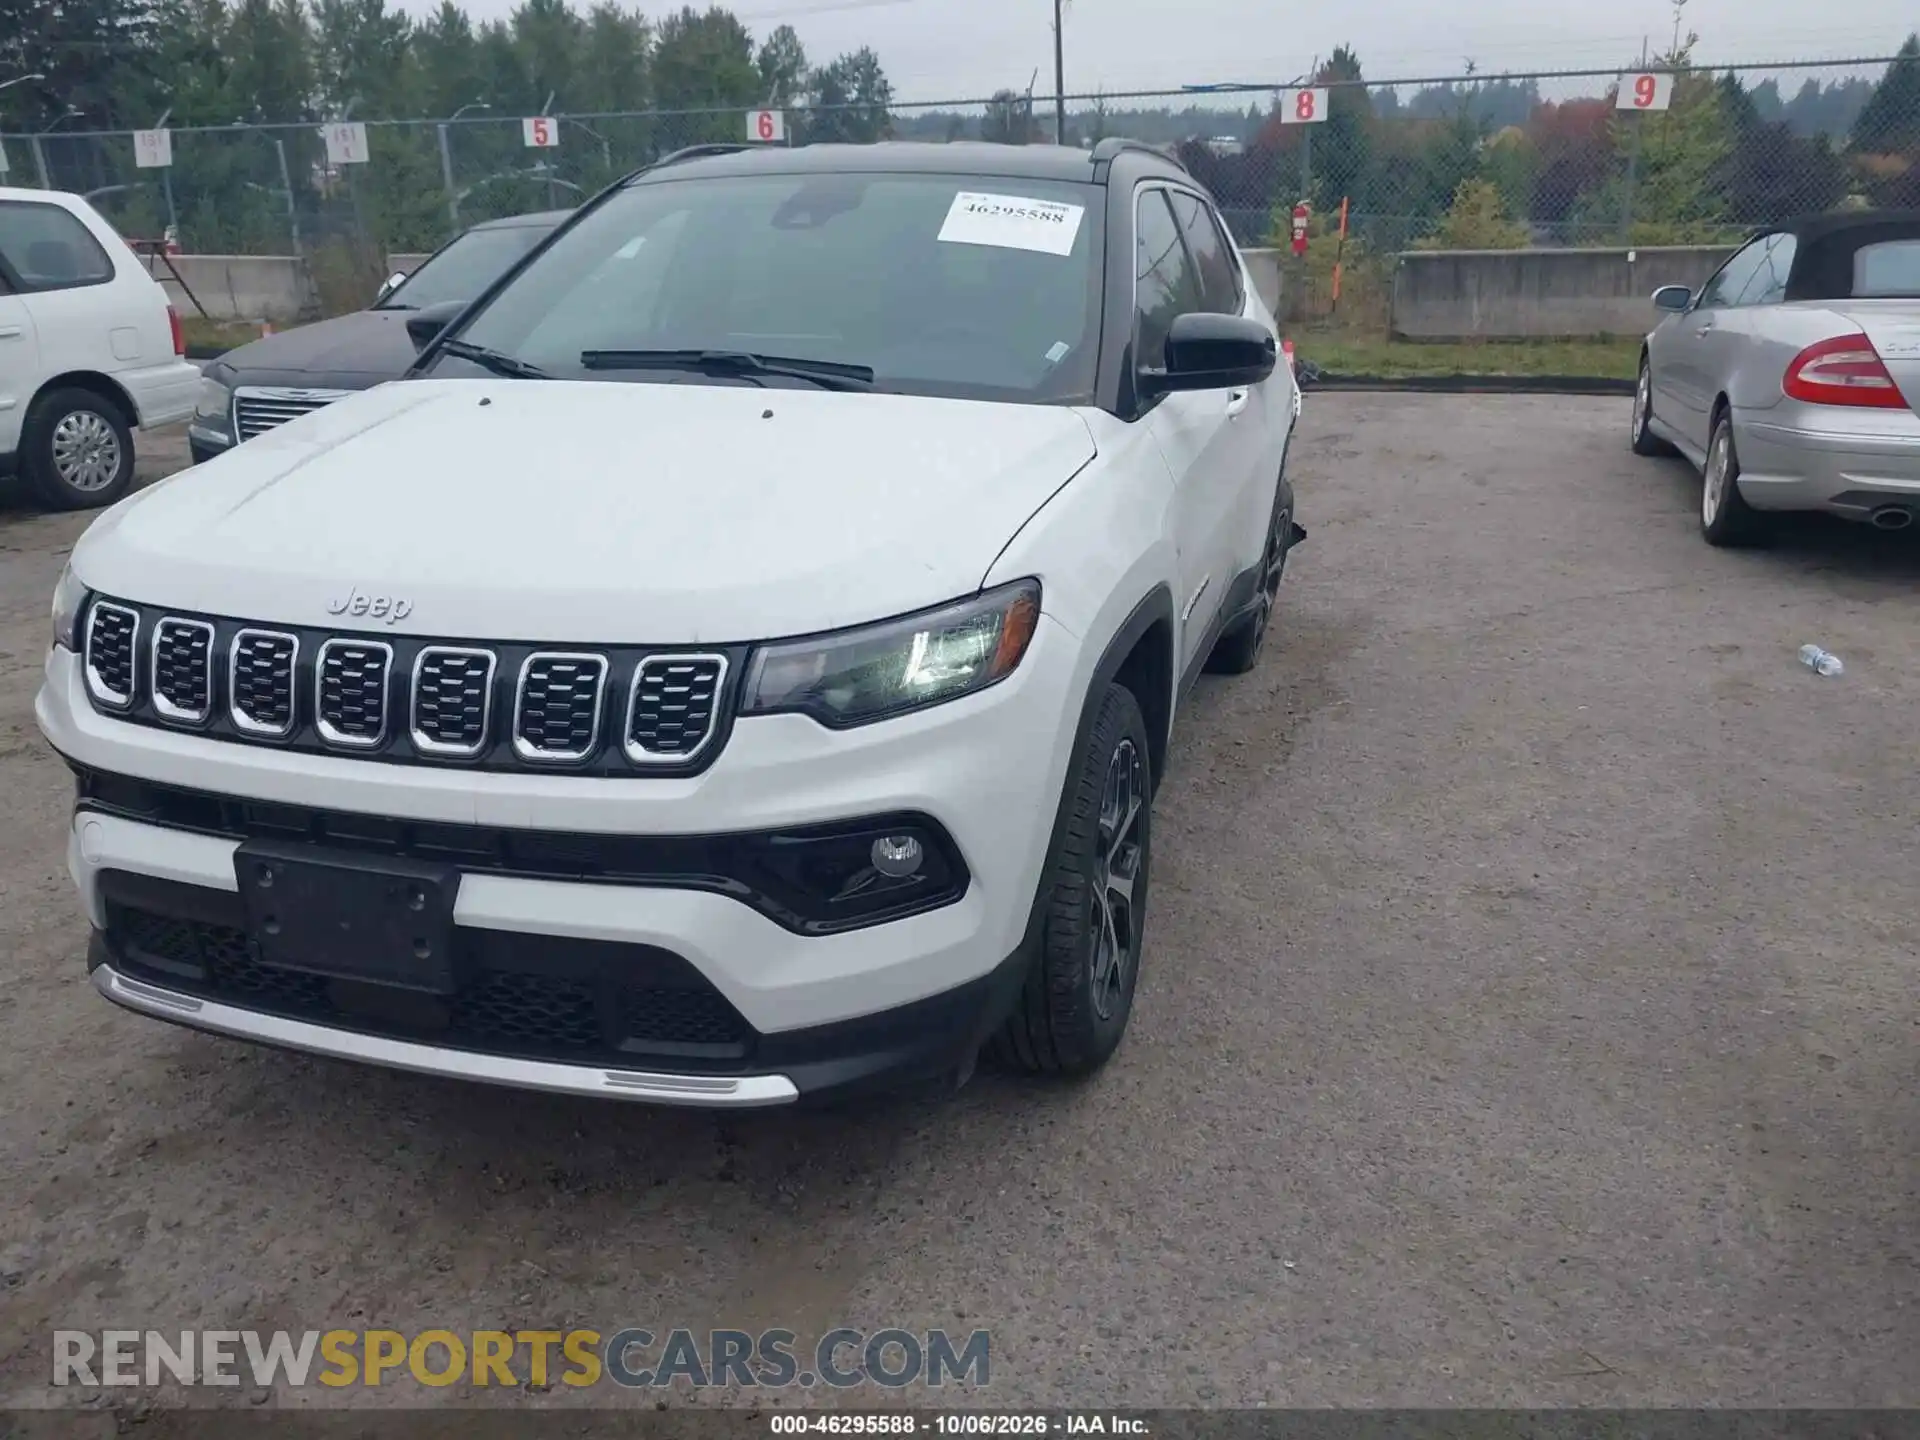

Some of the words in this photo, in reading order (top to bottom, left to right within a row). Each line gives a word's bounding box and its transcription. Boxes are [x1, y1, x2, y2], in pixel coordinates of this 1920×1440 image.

[1295, 90, 1314, 120] 8
[1633, 75, 1656, 107] 9
[532, 119, 549, 145] 5
[757, 111, 775, 139] 6
[964, 203, 1064, 223] 46295588
[327, 583, 414, 625] Jeep
